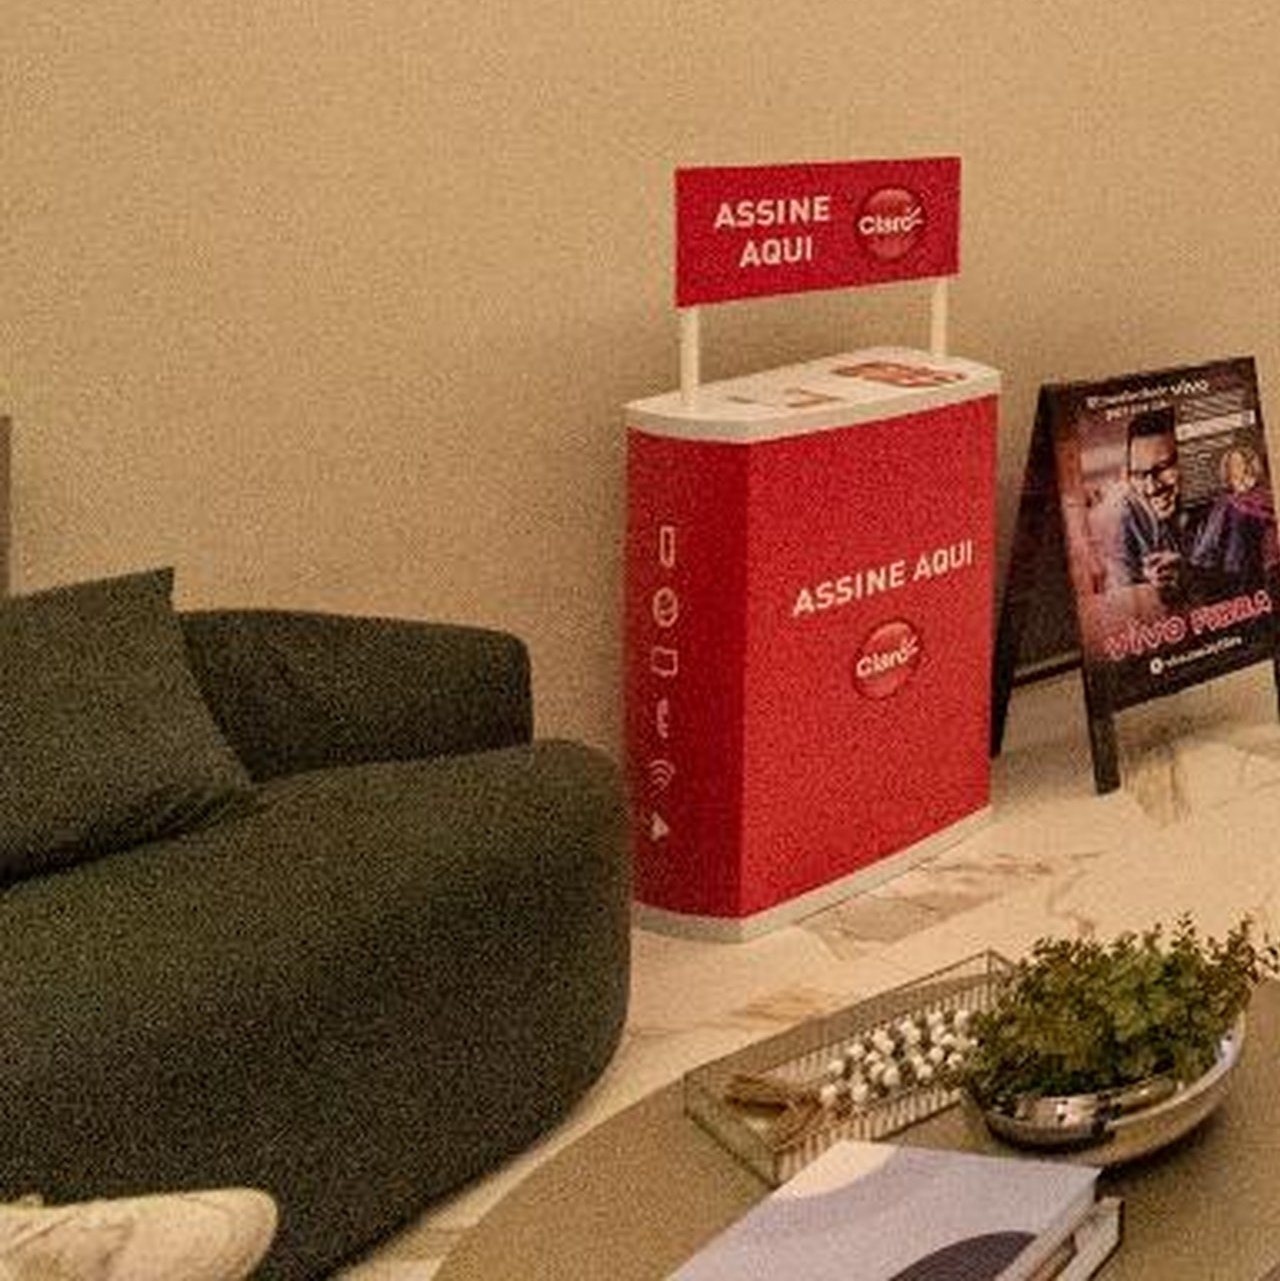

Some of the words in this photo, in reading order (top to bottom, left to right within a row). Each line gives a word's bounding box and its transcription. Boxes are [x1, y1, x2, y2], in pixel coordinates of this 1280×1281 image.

[715, 196, 830, 229] ASSINE
[857, 208, 921, 235] Claro
[739, 236, 812, 267] AQUI
[793, 560, 905, 617] ASSINE
[913, 539, 972, 581] AQUI
[856, 635, 919, 678] Claro
